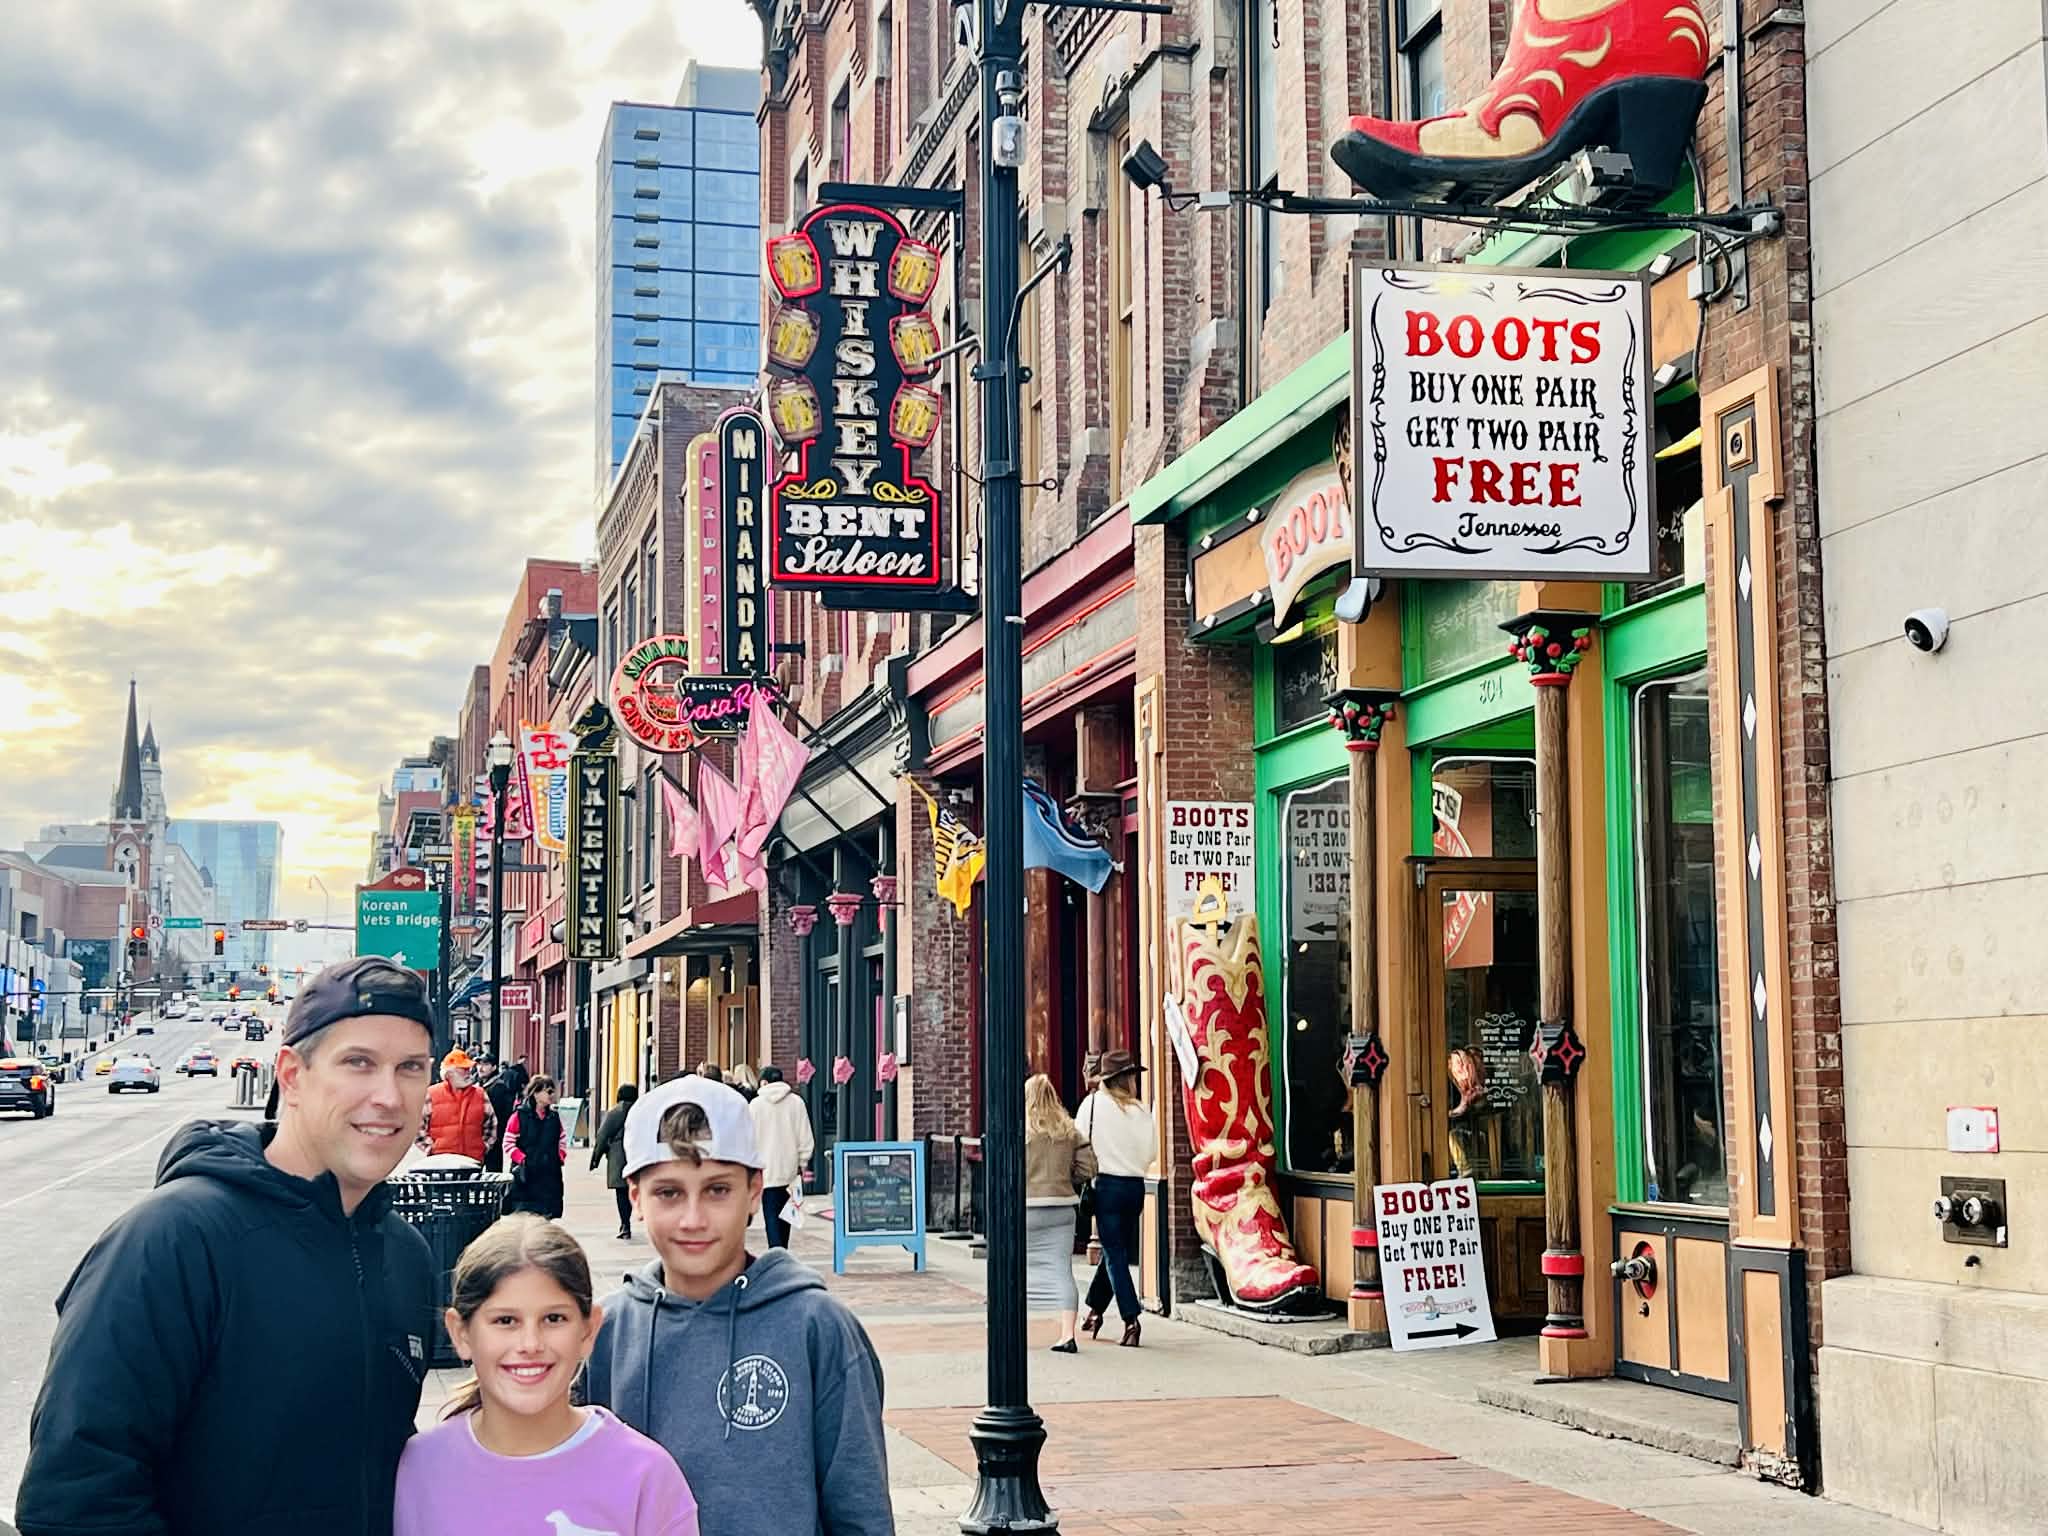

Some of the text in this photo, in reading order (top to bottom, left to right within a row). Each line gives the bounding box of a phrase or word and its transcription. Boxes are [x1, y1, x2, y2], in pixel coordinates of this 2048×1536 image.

[1404, 309, 1601, 365] BOOTS
[824, 219, 884, 496] WHISKEY
[1409, 371, 1605, 420] BUY ONE PAIR
[1406, 415, 1609, 463] GET TWO PAIR
[1431, 456, 1582, 508] FREE
[785, 503, 926, 539] BENT
[732, 428, 757, 662] MIRANDA
[784, 535, 926, 576] Saloon
[618, 695, 665, 744] CANDY
[1172, 806, 1249, 828] BOOTS
[1170, 830, 1251, 849] Buy ONE Pair
[580, 767, 606, 958] VALENTINE
[1170, 850, 1251, 867] Get TWO Pair
[362, 900, 408, 911] Korean
[363, 913, 439, 929] Vets Bridge
[1381, 1185, 1471, 1216] BOOTS
[1381, 1213, 1476, 1242] Buy ONE Pair
[1384, 1237, 1478, 1262] Get TWO Pair
[1403, 1263, 1467, 1293] FREE!
